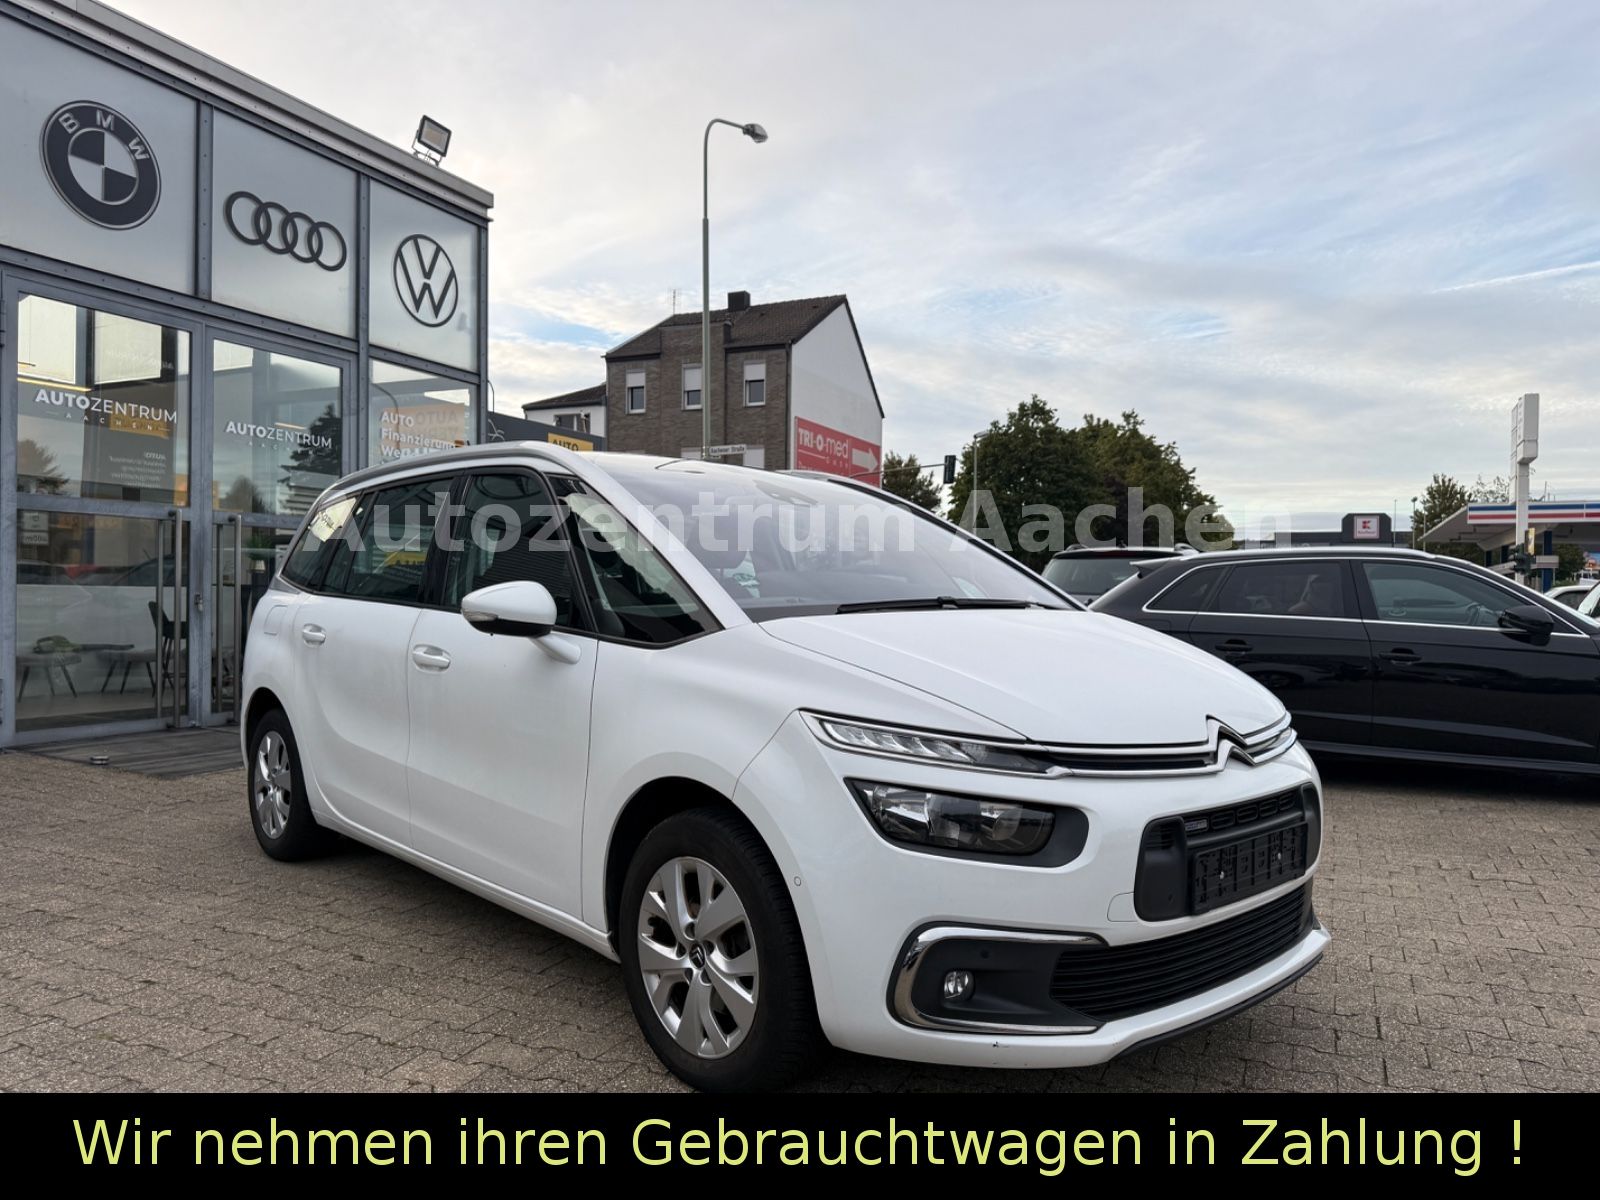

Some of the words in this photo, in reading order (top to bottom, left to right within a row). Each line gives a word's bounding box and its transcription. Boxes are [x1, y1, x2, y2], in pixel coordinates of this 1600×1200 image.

[58, 109, 150, 160] BMW
[35, 388, 178, 424] AUTOZENTRUM
[381, 411, 415, 428] AUTO
[225, 420, 333, 449] AUTOZENTRUM
